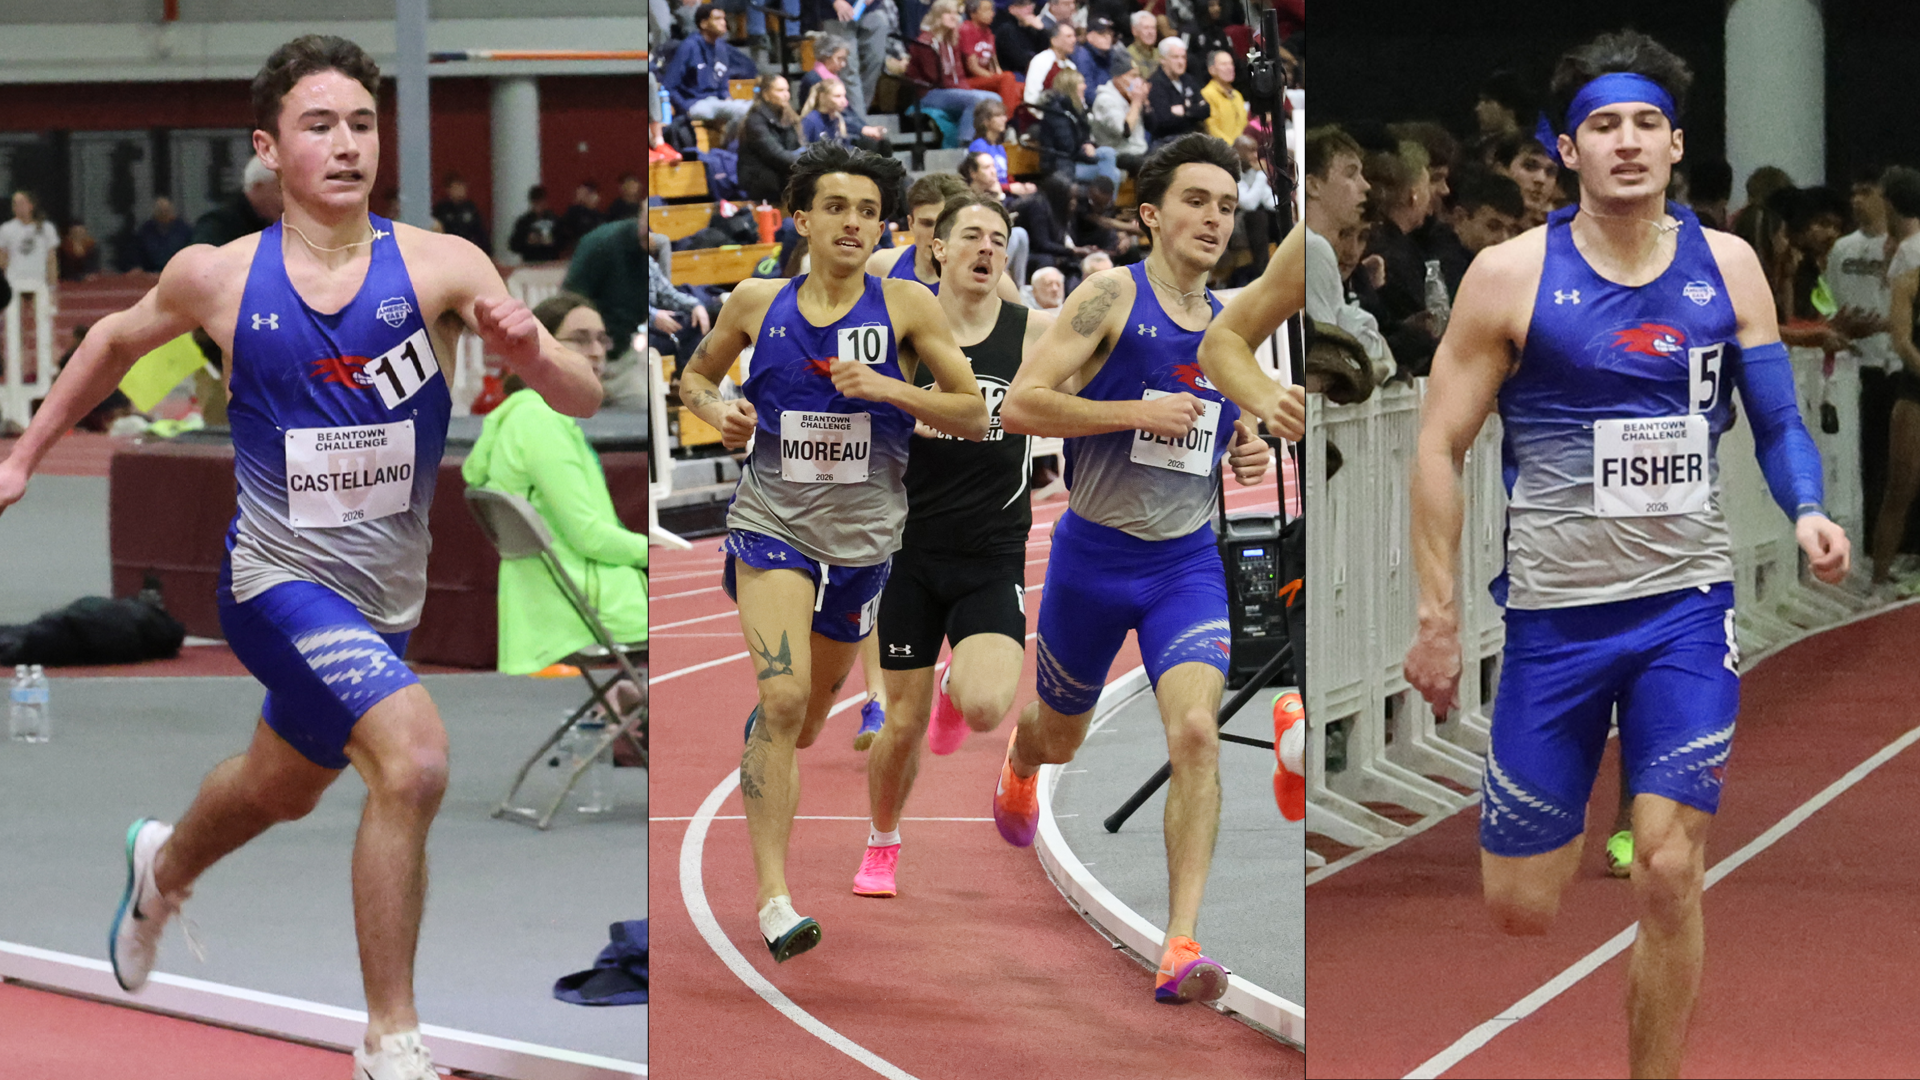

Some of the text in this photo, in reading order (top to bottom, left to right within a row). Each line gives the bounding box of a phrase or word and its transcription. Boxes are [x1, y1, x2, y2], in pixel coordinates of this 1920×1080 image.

[847, 328, 881, 362] 10
[375, 340, 427, 400] 11
[1698, 349, 1718, 410] 5
[981, 386, 1008, 417] 2
[802, 414, 850, 423] BEANTOWN
[800, 421, 852, 430] CHALLENGE
[1623, 421, 1686, 432] BEANTOWN
[317, 428, 386, 442] BEANTOWN
[982, 429, 1004, 441] ELD
[1621, 430, 1687, 441] CHALLENGE
[315, 437, 388, 451] CHALLENGE
[782, 439, 868, 461] MOREAU
[1167, 458, 1186, 470] 2026
[1602, 453, 1702, 487] FISHER
[290, 463, 411, 492] CASTELLANO
[815, 473, 834, 481] 2026
[1646, 502, 1669, 513] 2026
[342, 509, 365, 522] 2026
